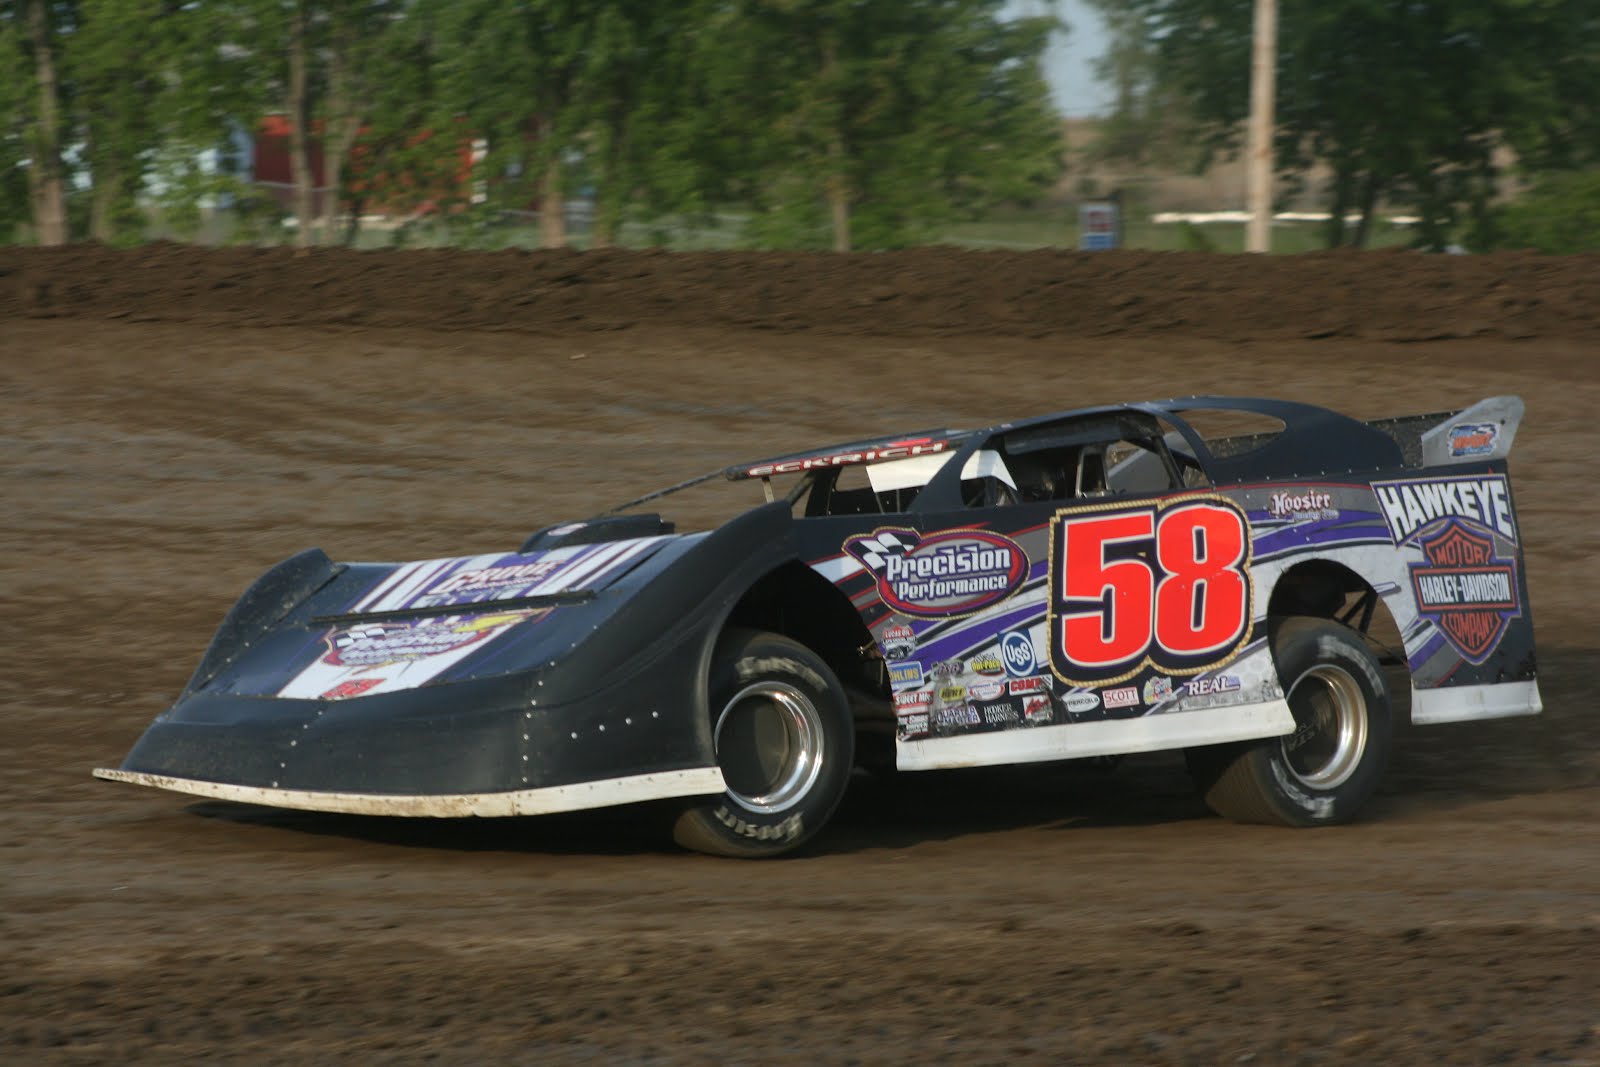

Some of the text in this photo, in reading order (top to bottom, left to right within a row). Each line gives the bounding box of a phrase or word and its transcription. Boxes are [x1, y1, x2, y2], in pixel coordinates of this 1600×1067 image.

[1270, 490, 1331, 515] Hoosier
[1376, 479, 1515, 541] HAWKEYE
[884, 545, 1011, 581] Precision
[1435, 535, 1484, 565] MOTOR
[899, 574, 1008, 601] Performance
[1062, 505, 1246, 667] 58
[1419, 572, 1511, 604] HARLEY-DAVIDSON
[1447, 612, 1494, 648] COMPANY
[1005, 642, 1031, 666] USS
[1104, 689, 1136, 703] SCOTT
[1187, 679, 1229, 696] REAL
